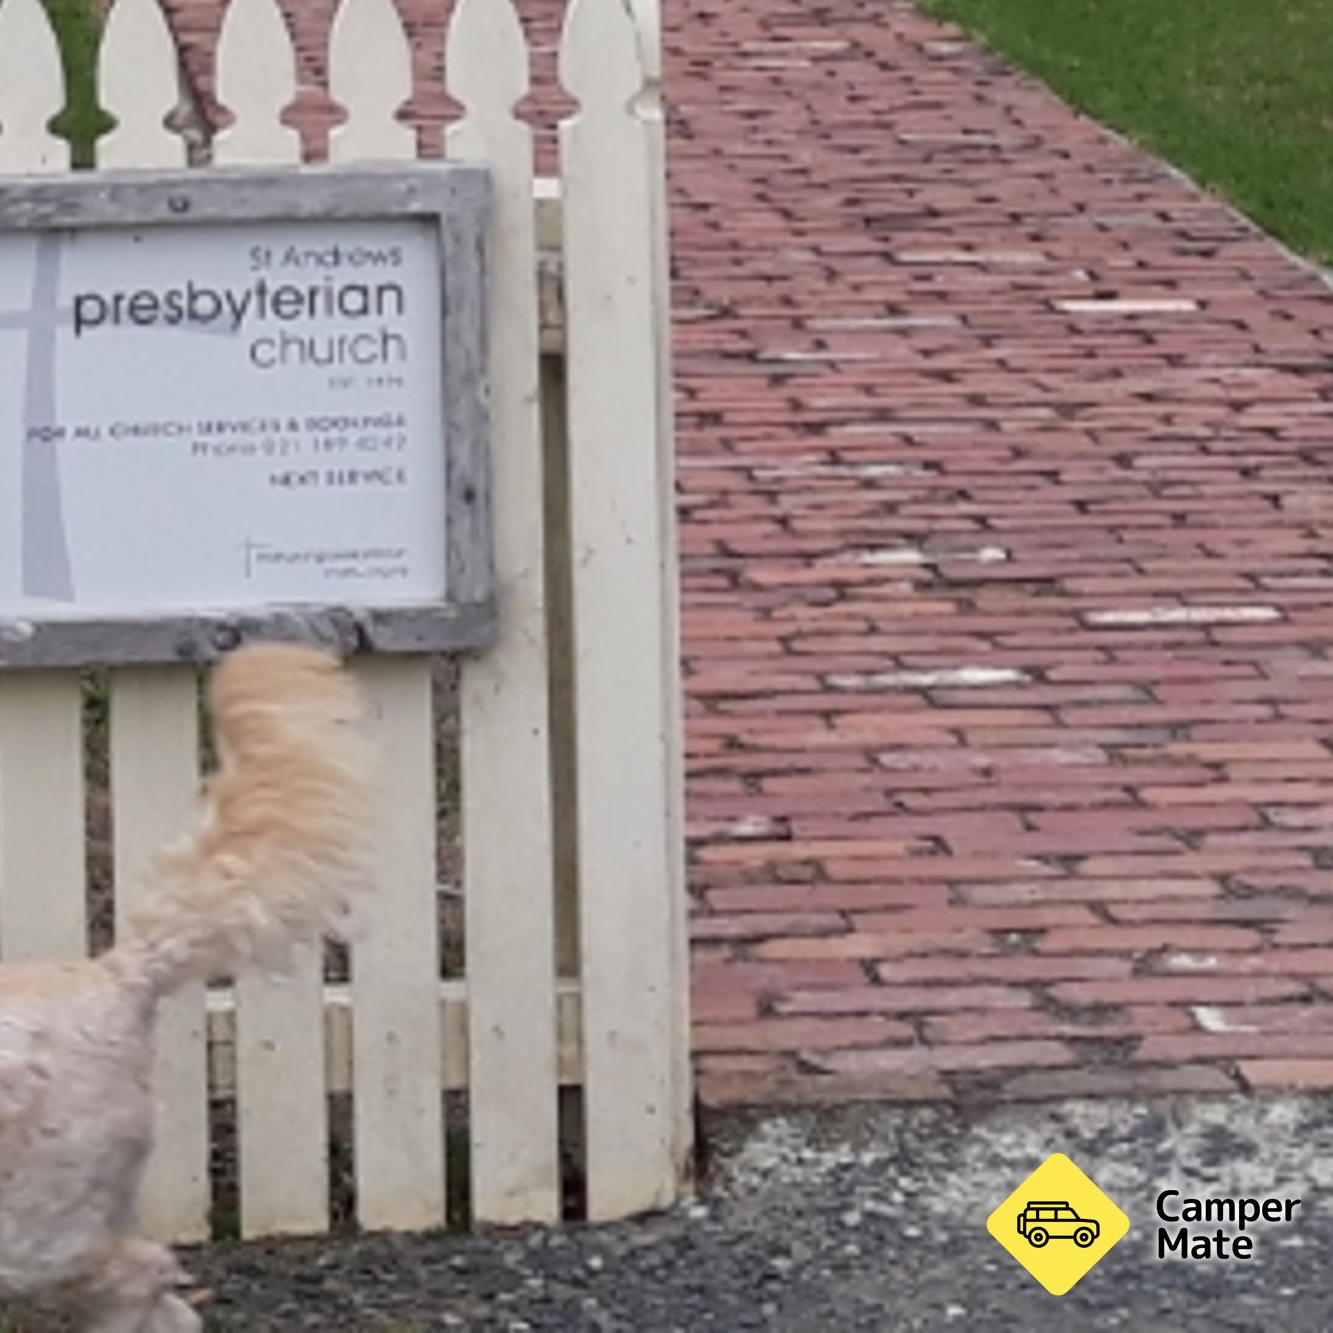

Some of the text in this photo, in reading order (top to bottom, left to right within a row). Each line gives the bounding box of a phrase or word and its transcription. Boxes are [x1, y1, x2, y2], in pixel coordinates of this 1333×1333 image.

[249, 243, 404, 271] St Andrews
[73, 277, 405, 339] presbyterian
[249, 326, 407, 369] church
